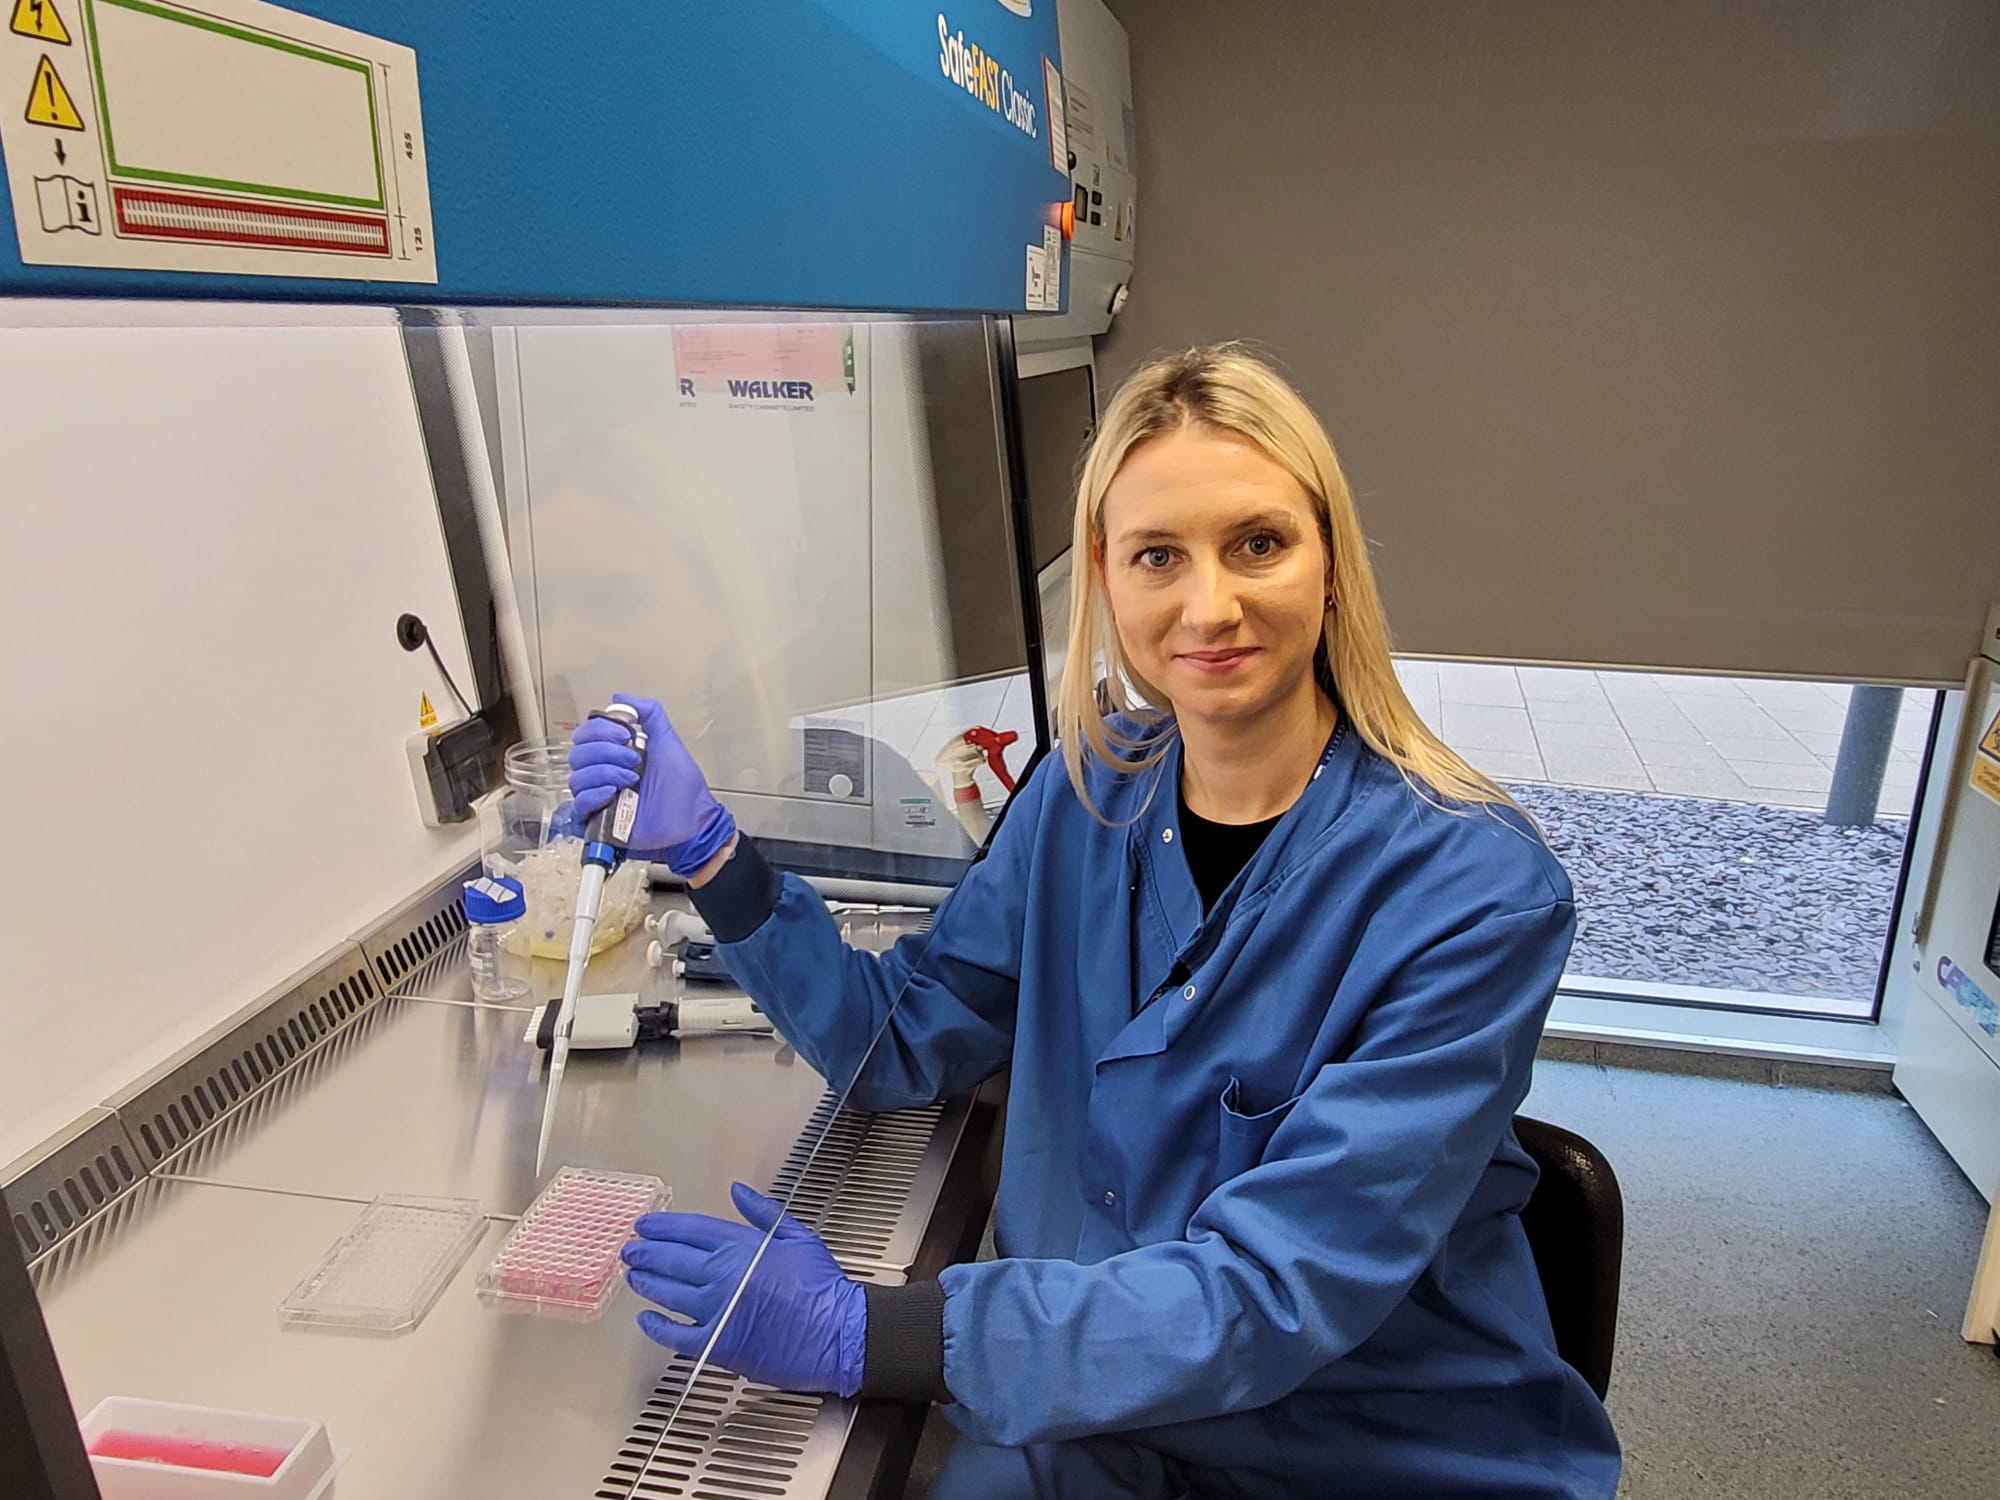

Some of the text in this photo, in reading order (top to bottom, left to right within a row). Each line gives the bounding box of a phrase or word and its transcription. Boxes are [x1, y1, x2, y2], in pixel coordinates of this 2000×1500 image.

[937, 13, 1000, 113] SafeFAST
[1001, 69, 1037, 139] Classic
[404, 132, 413, 160] 455
[414, 226, 423, 252] 125
[727, 379, 814, 401] WALKER
